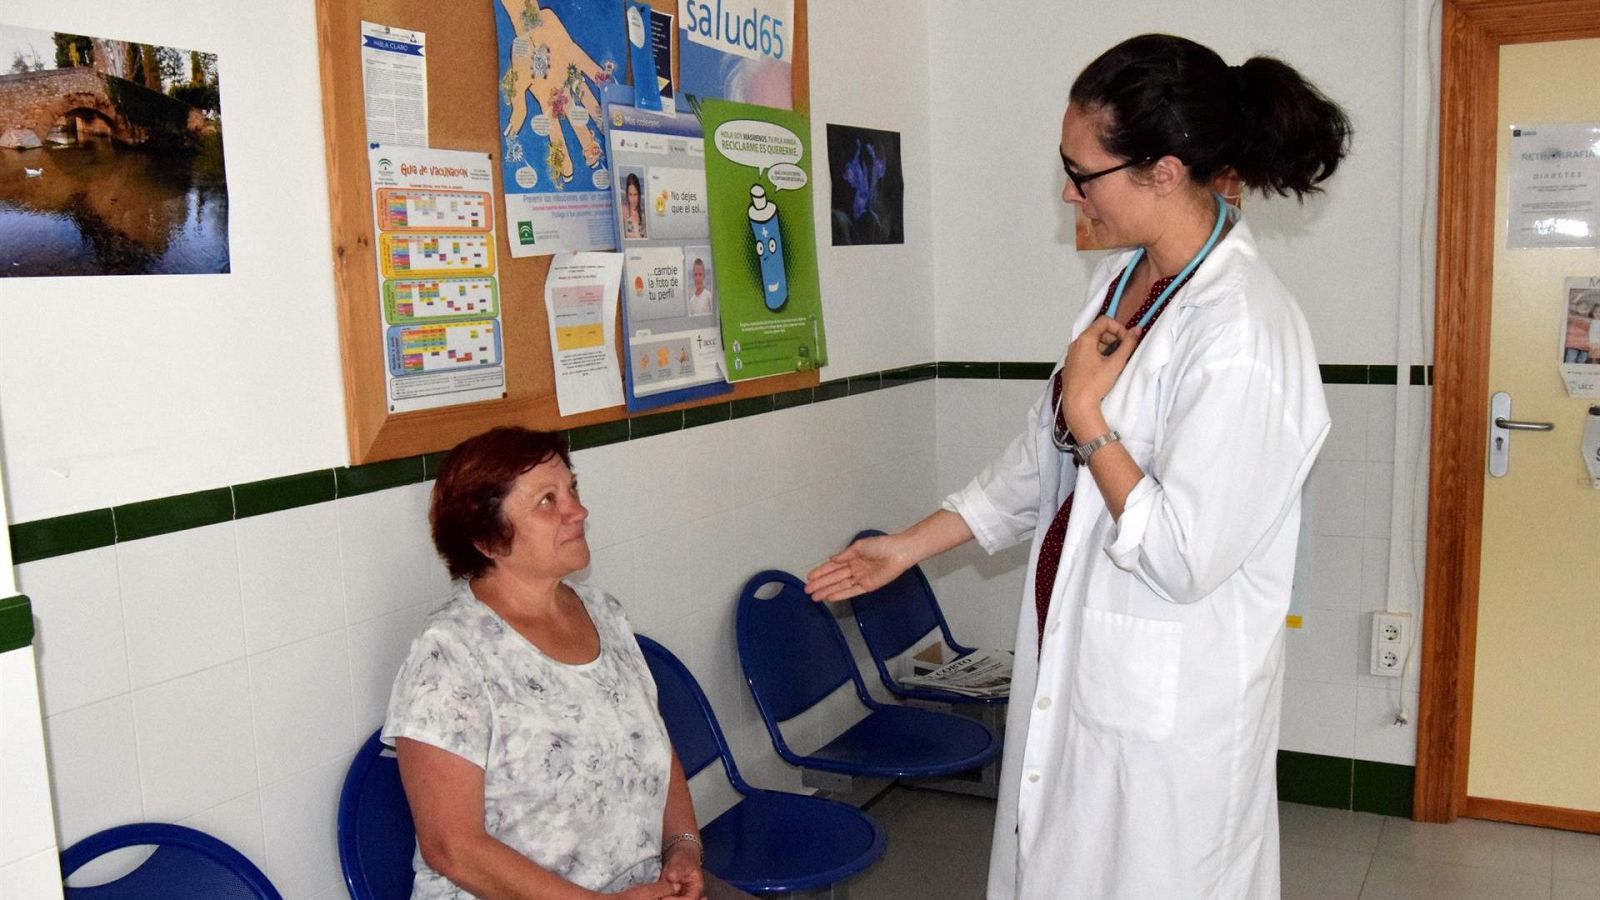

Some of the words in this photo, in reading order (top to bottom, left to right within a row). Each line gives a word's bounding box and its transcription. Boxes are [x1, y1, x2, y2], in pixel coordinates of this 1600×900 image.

[687, 0, 783, 59] salud65
[721, 131, 733, 140] HOLA
[721, 139, 759, 152] RECICLARME
[759, 143, 767, 153] ES
[671, 191, 680, 200] No
[681, 192, 697, 203] dejes
[671, 204, 683, 214] que
[684, 203, 690, 213] el
[648, 278, 655, 289] la
[656, 278, 669, 288] foto
[670, 277, 679, 287] de
[649, 290, 656, 300] tu
[658, 289, 675, 303] perfil
